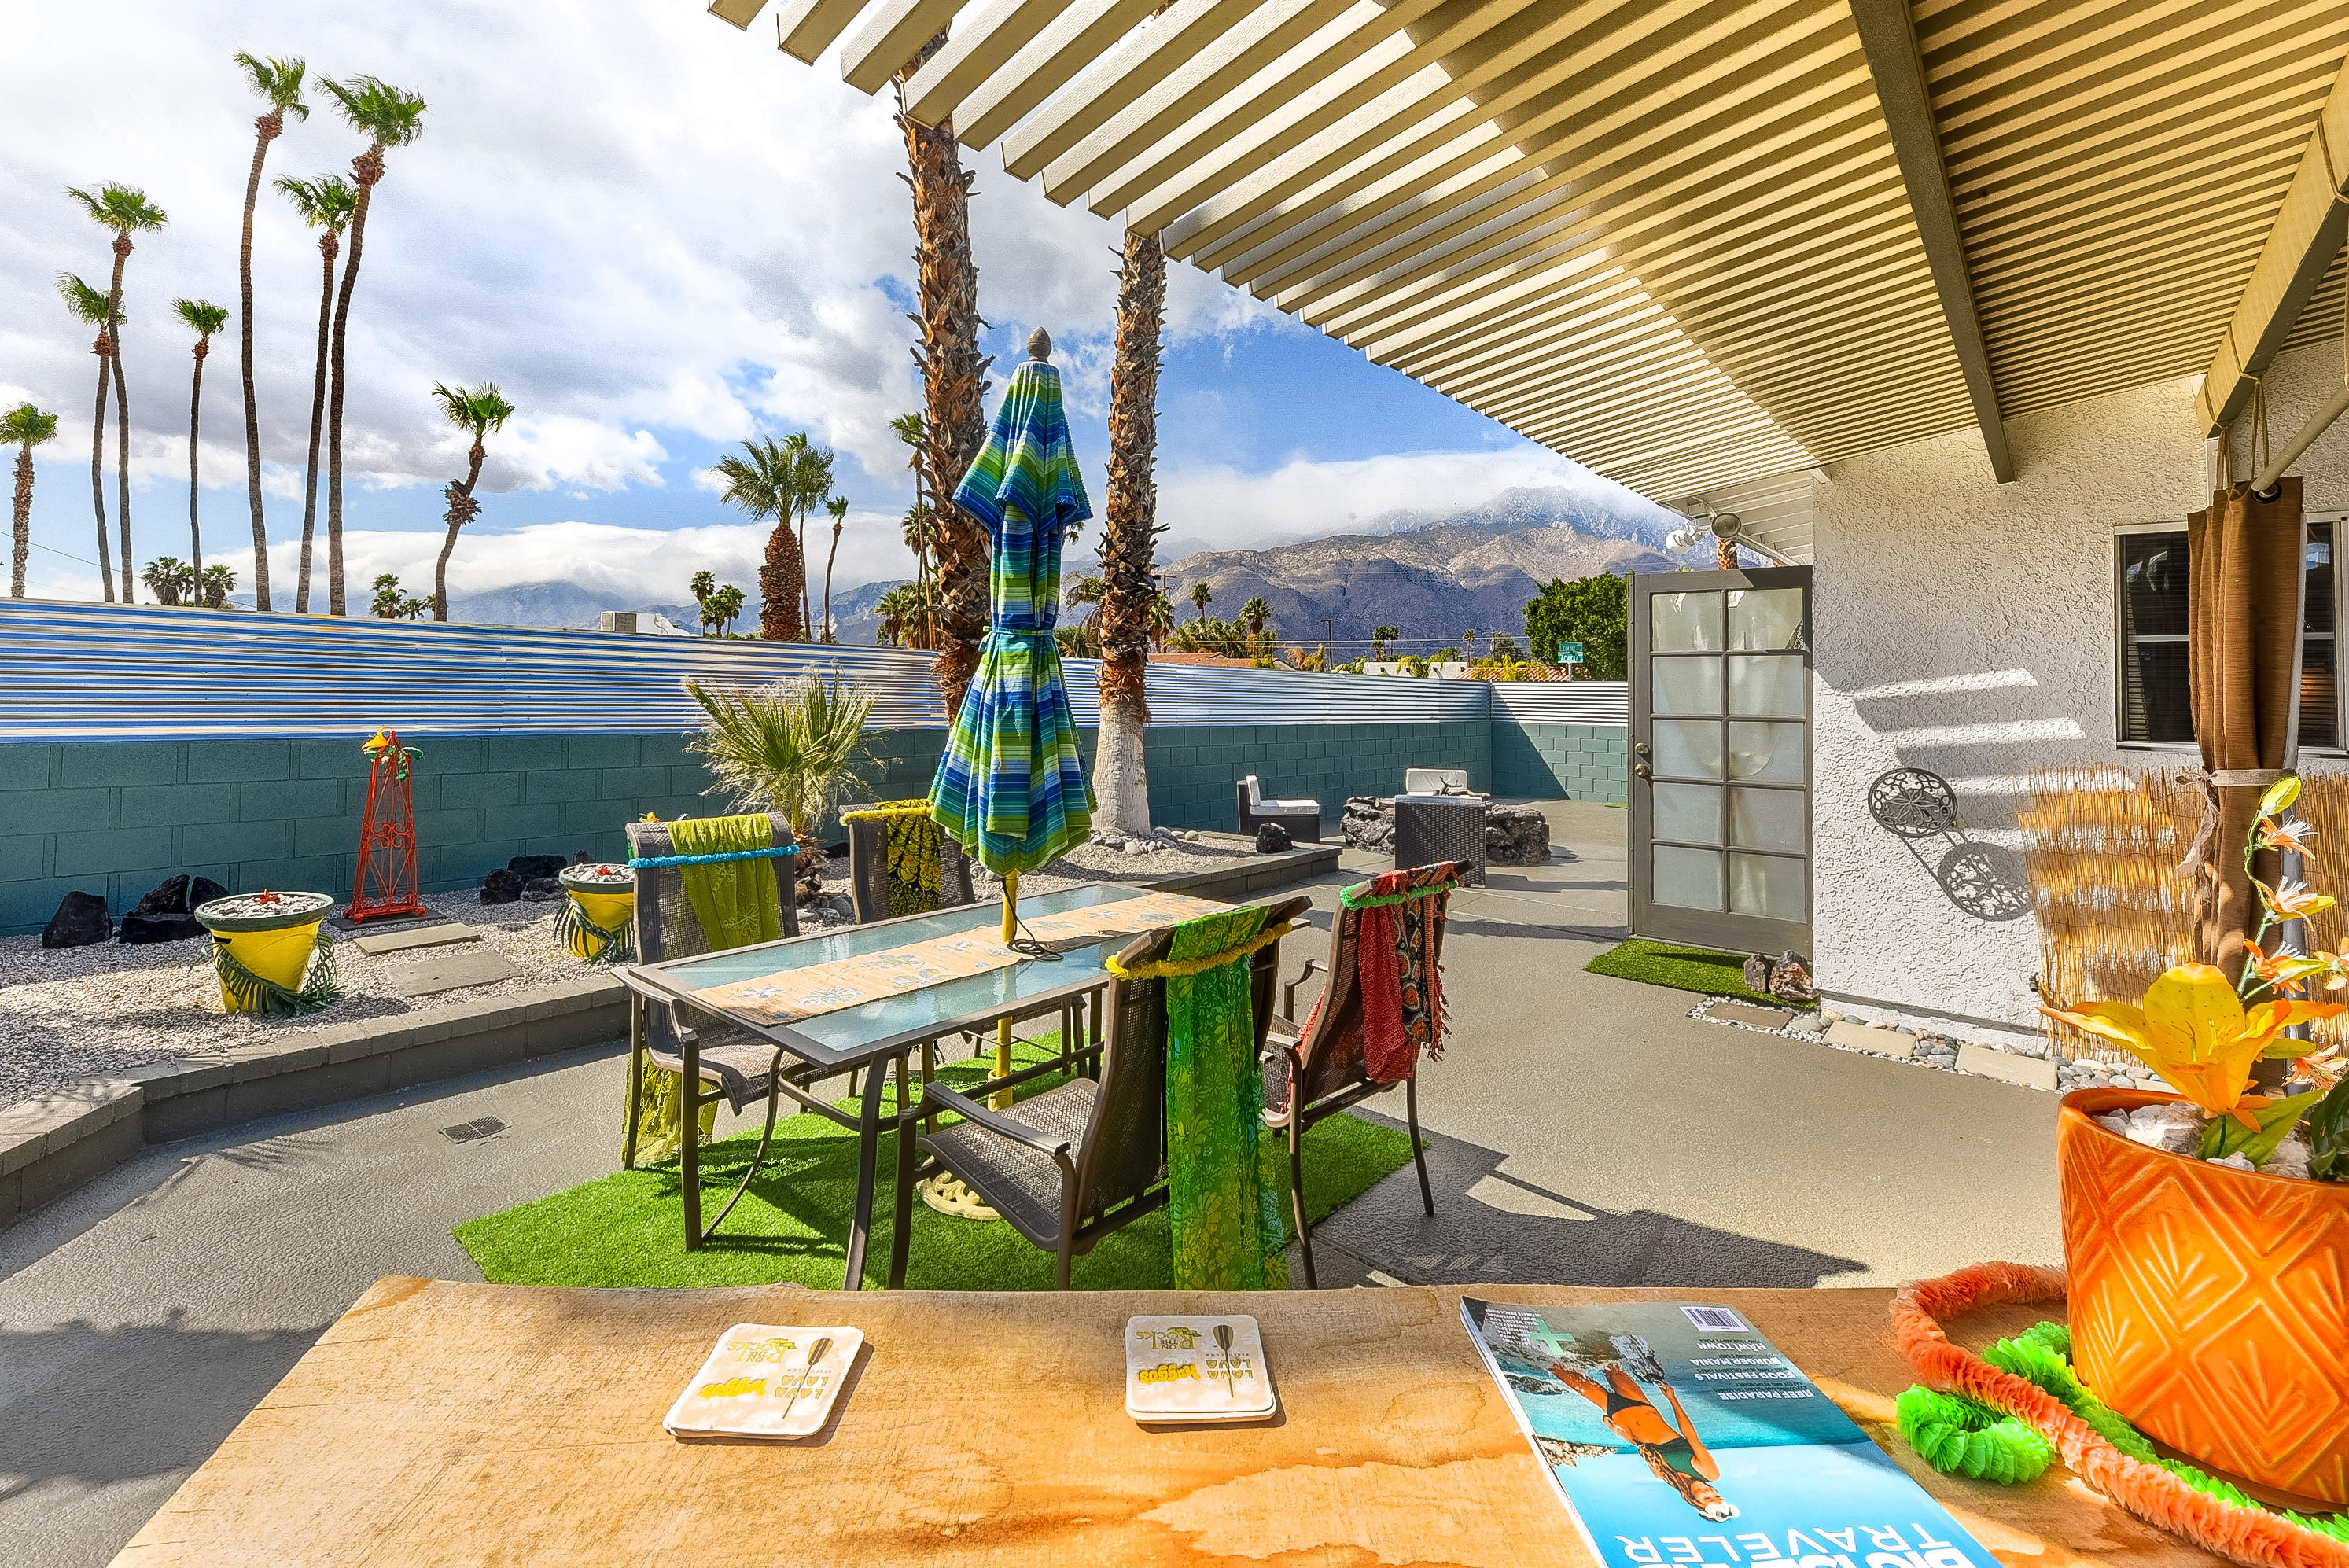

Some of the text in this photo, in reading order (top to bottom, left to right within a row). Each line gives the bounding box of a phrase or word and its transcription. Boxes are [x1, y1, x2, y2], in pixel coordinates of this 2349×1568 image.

[1206, 1359, 1252, 1369] LAVA
[1689, 1357, 1782, 1367] BURGER MANIA
[1207, 1369, 1254, 1379] LAVA
[1694, 1371, 1795, 1381] FOOD FESTIVALS
[782, 1375, 829, 1386] LAVA
[775, 1387, 823, 1400] LAVA
[1718, 1389, 1815, 1401] REEF PARADISE
[1614, 1522, 1950, 1563] TRAVELER
